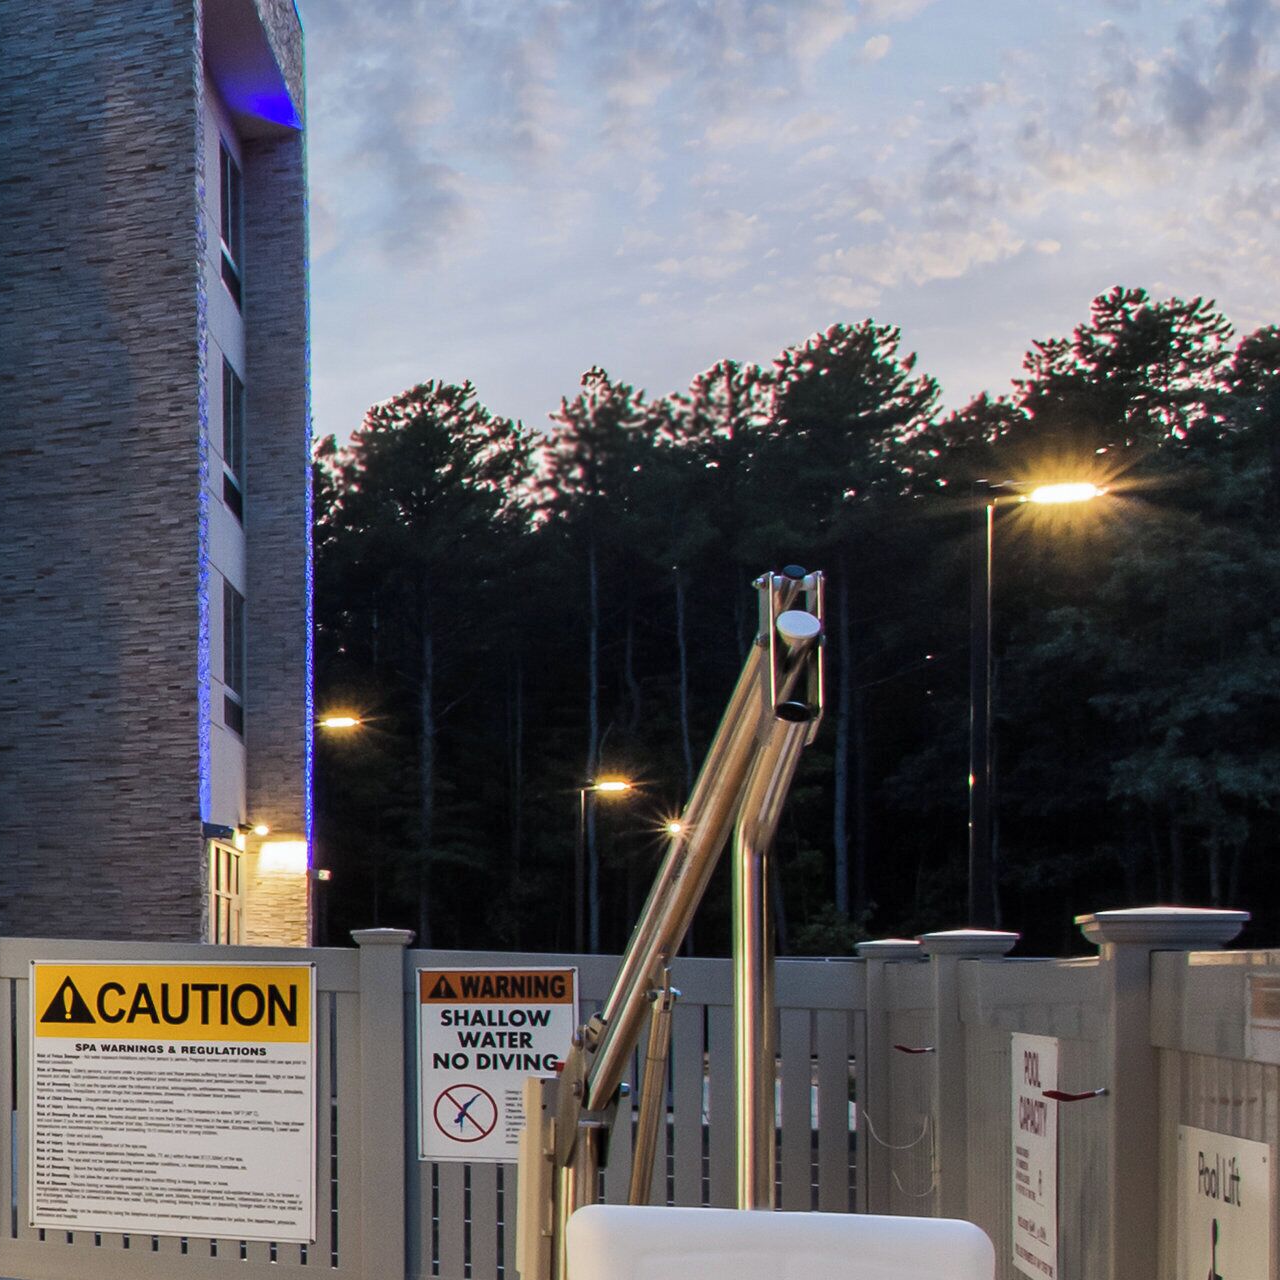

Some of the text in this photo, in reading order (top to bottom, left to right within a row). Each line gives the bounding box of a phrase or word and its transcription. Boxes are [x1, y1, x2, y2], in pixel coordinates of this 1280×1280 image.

[460, 976, 565, 999] WARNING
[96, 982, 297, 1026] CAUTION
[440, 1010, 551, 1026] SHALLOW
[76, 1043, 267, 1056] SPA WARNINGS & REGULATIONS
[458, 1032, 533, 1048] WATER
[433, 1053, 559, 1071] NO DIVING
[1024, 1050, 1041, 1088] POOL
[1019, 1096, 1048, 1138] CAPACITY
[1198, 1152, 1242, 1207] Pool Lift
